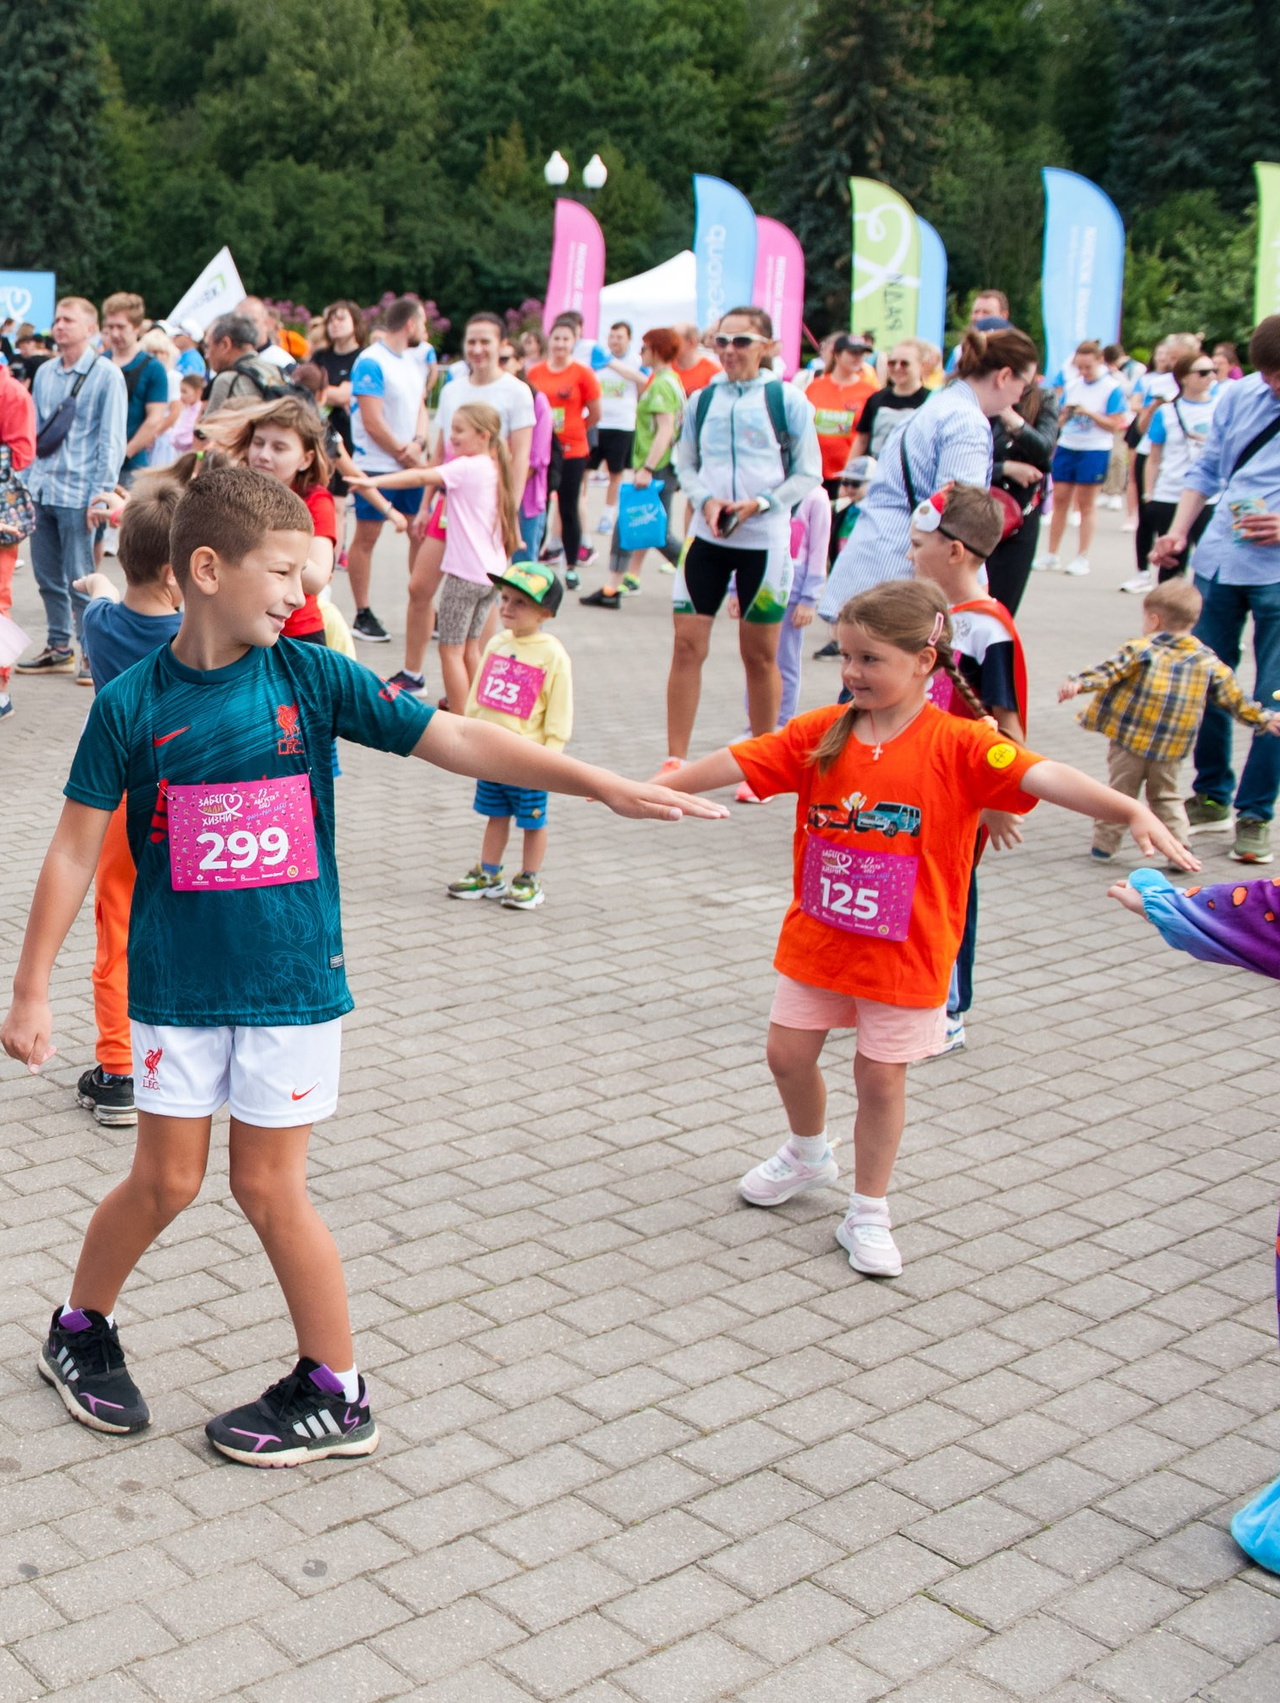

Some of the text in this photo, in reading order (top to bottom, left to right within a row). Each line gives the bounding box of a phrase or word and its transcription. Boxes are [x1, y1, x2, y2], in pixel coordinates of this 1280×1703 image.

[484, 676, 521, 704] 123
[198, 793, 223, 807] ЗАБЕГ
[201, 813, 232, 826] ЖИЗНИ
[196, 827, 289, 869] 299
[820, 877, 879, 919] 125
